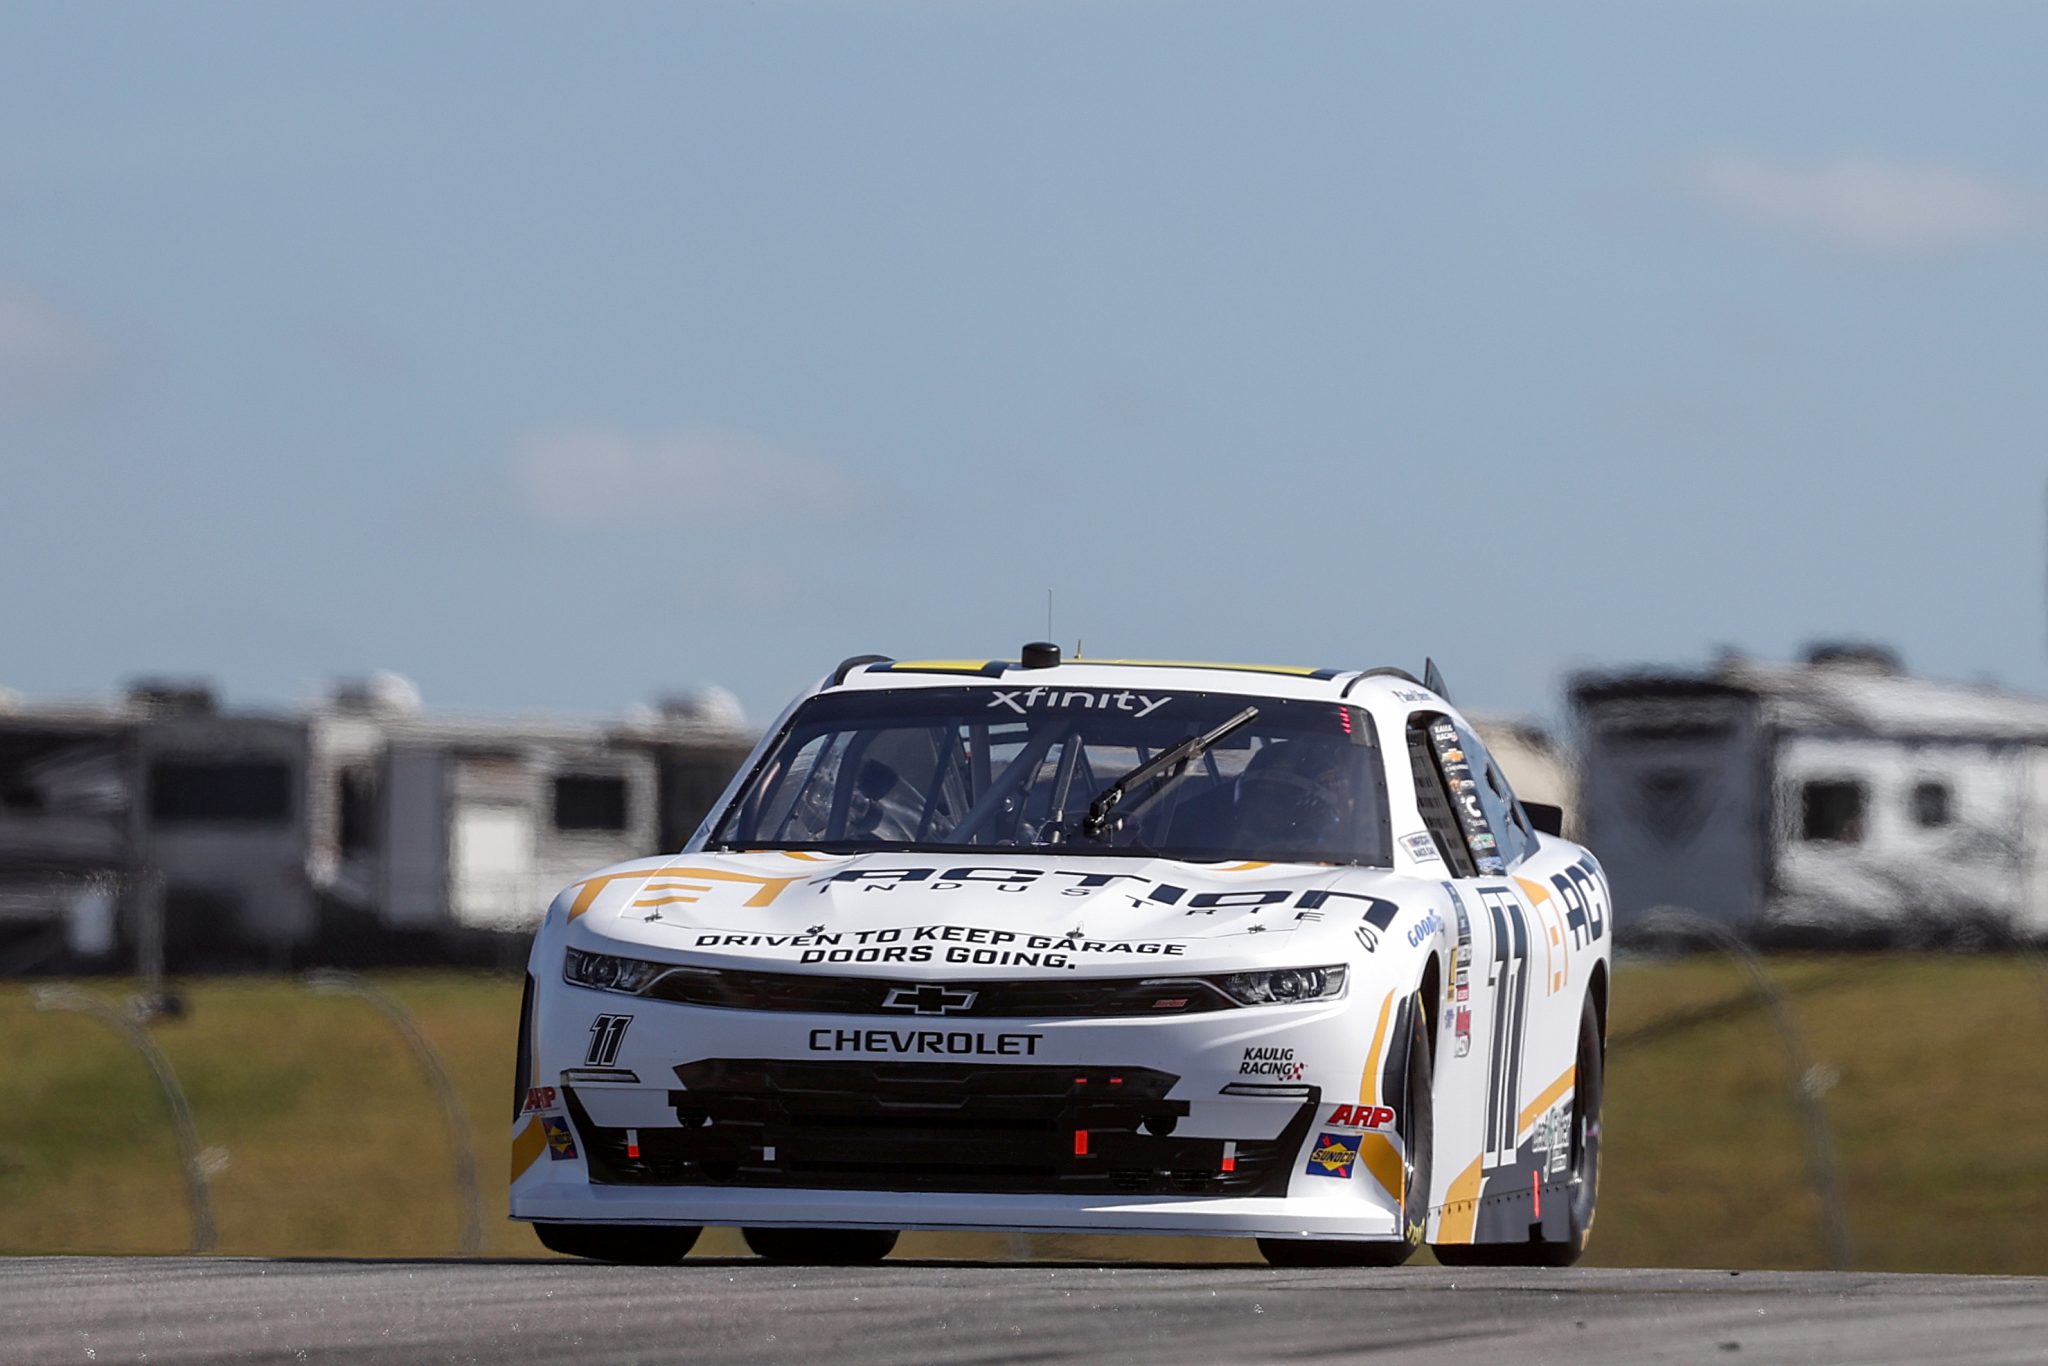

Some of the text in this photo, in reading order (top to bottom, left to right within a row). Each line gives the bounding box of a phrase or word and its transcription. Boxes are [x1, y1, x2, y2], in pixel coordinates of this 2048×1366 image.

[695, 926, 1187, 956] DRIVEN TO KEEP GARAGE
[800, 946, 1076, 970] DOORS GOING.
[585, 1013, 634, 1067] 11
[809, 1029, 1043, 1056] CHEVROLET
[1244, 1047, 1294, 1061] KAULIG
[1239, 1061, 1292, 1075] RACING
[1327, 1103, 1394, 1128] ARP
[1313, 1150, 1354, 1164] SUNOCO
